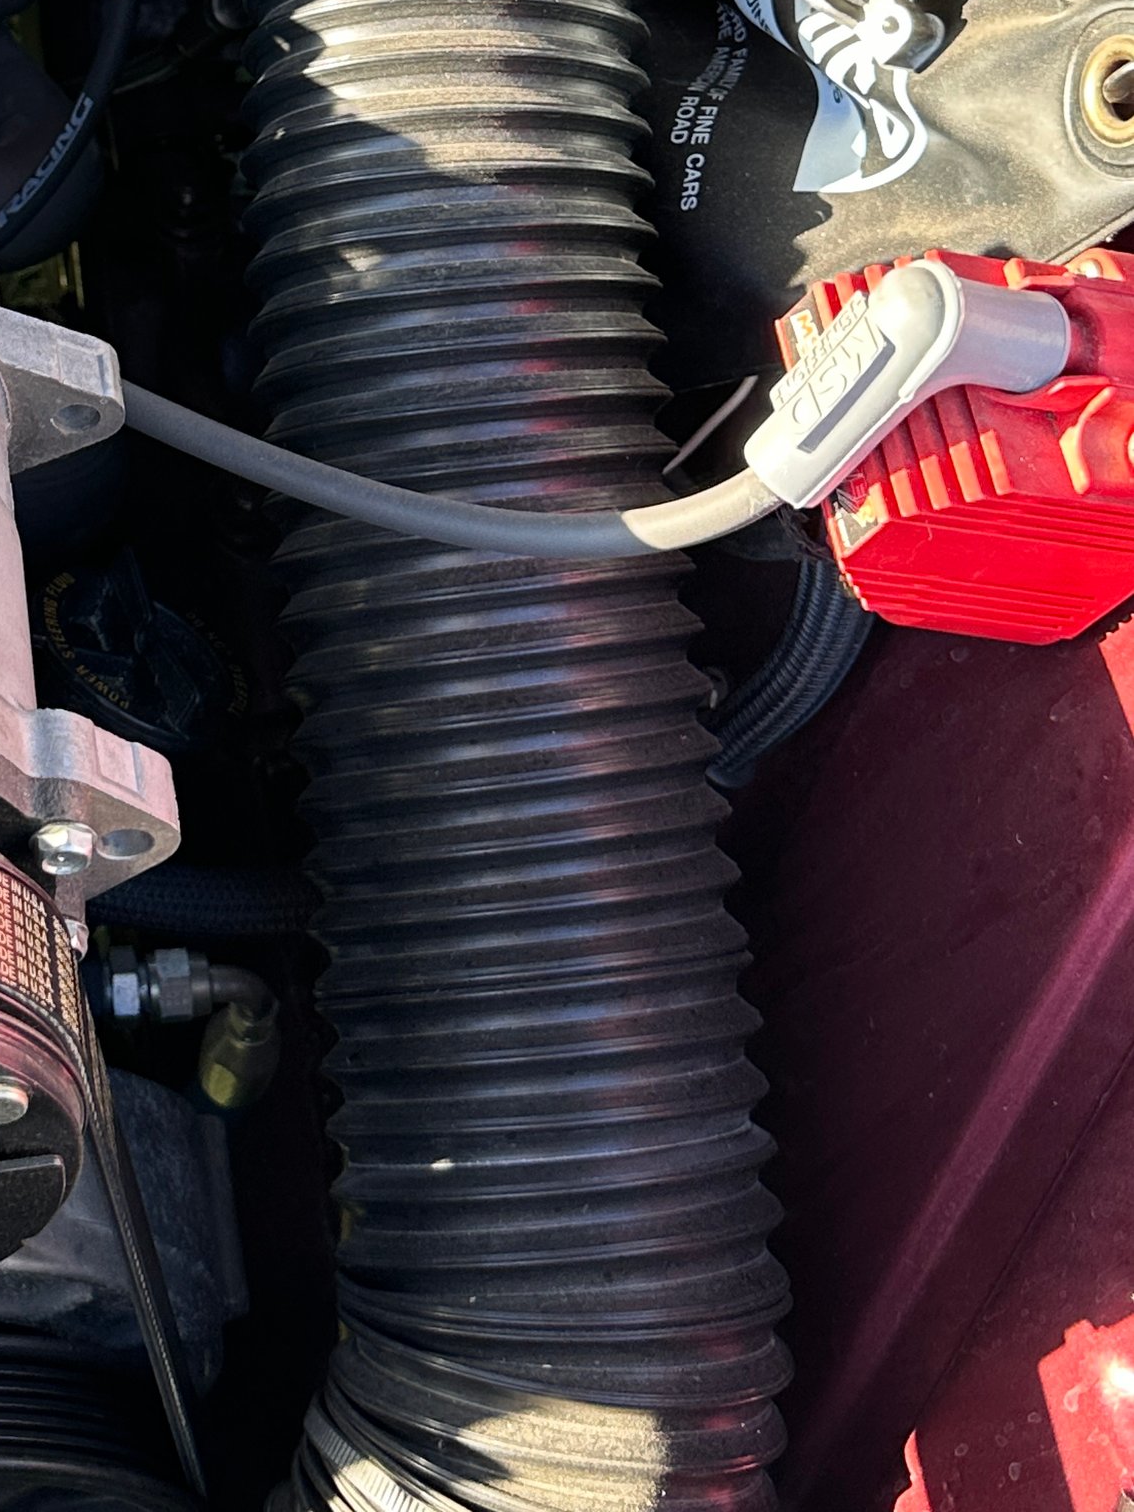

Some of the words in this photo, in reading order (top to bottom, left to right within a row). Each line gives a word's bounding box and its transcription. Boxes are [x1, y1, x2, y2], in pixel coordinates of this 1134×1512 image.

[707, 88, 728, 101] OF
[670, 96, 700, 144] ROAD
[691, 106, 718, 145] FINE
[680, 153, 705, 211] CARS
[11, 879, 22, 897] IN
[12, 894, 23, 911] IN
[13, 909, 24, 926] IN
[14, 924, 25, 941] IN
[15, 940, 26, 957] IN
[16, 955, 28, 972] IN
[18, 970, 29, 987] IN
